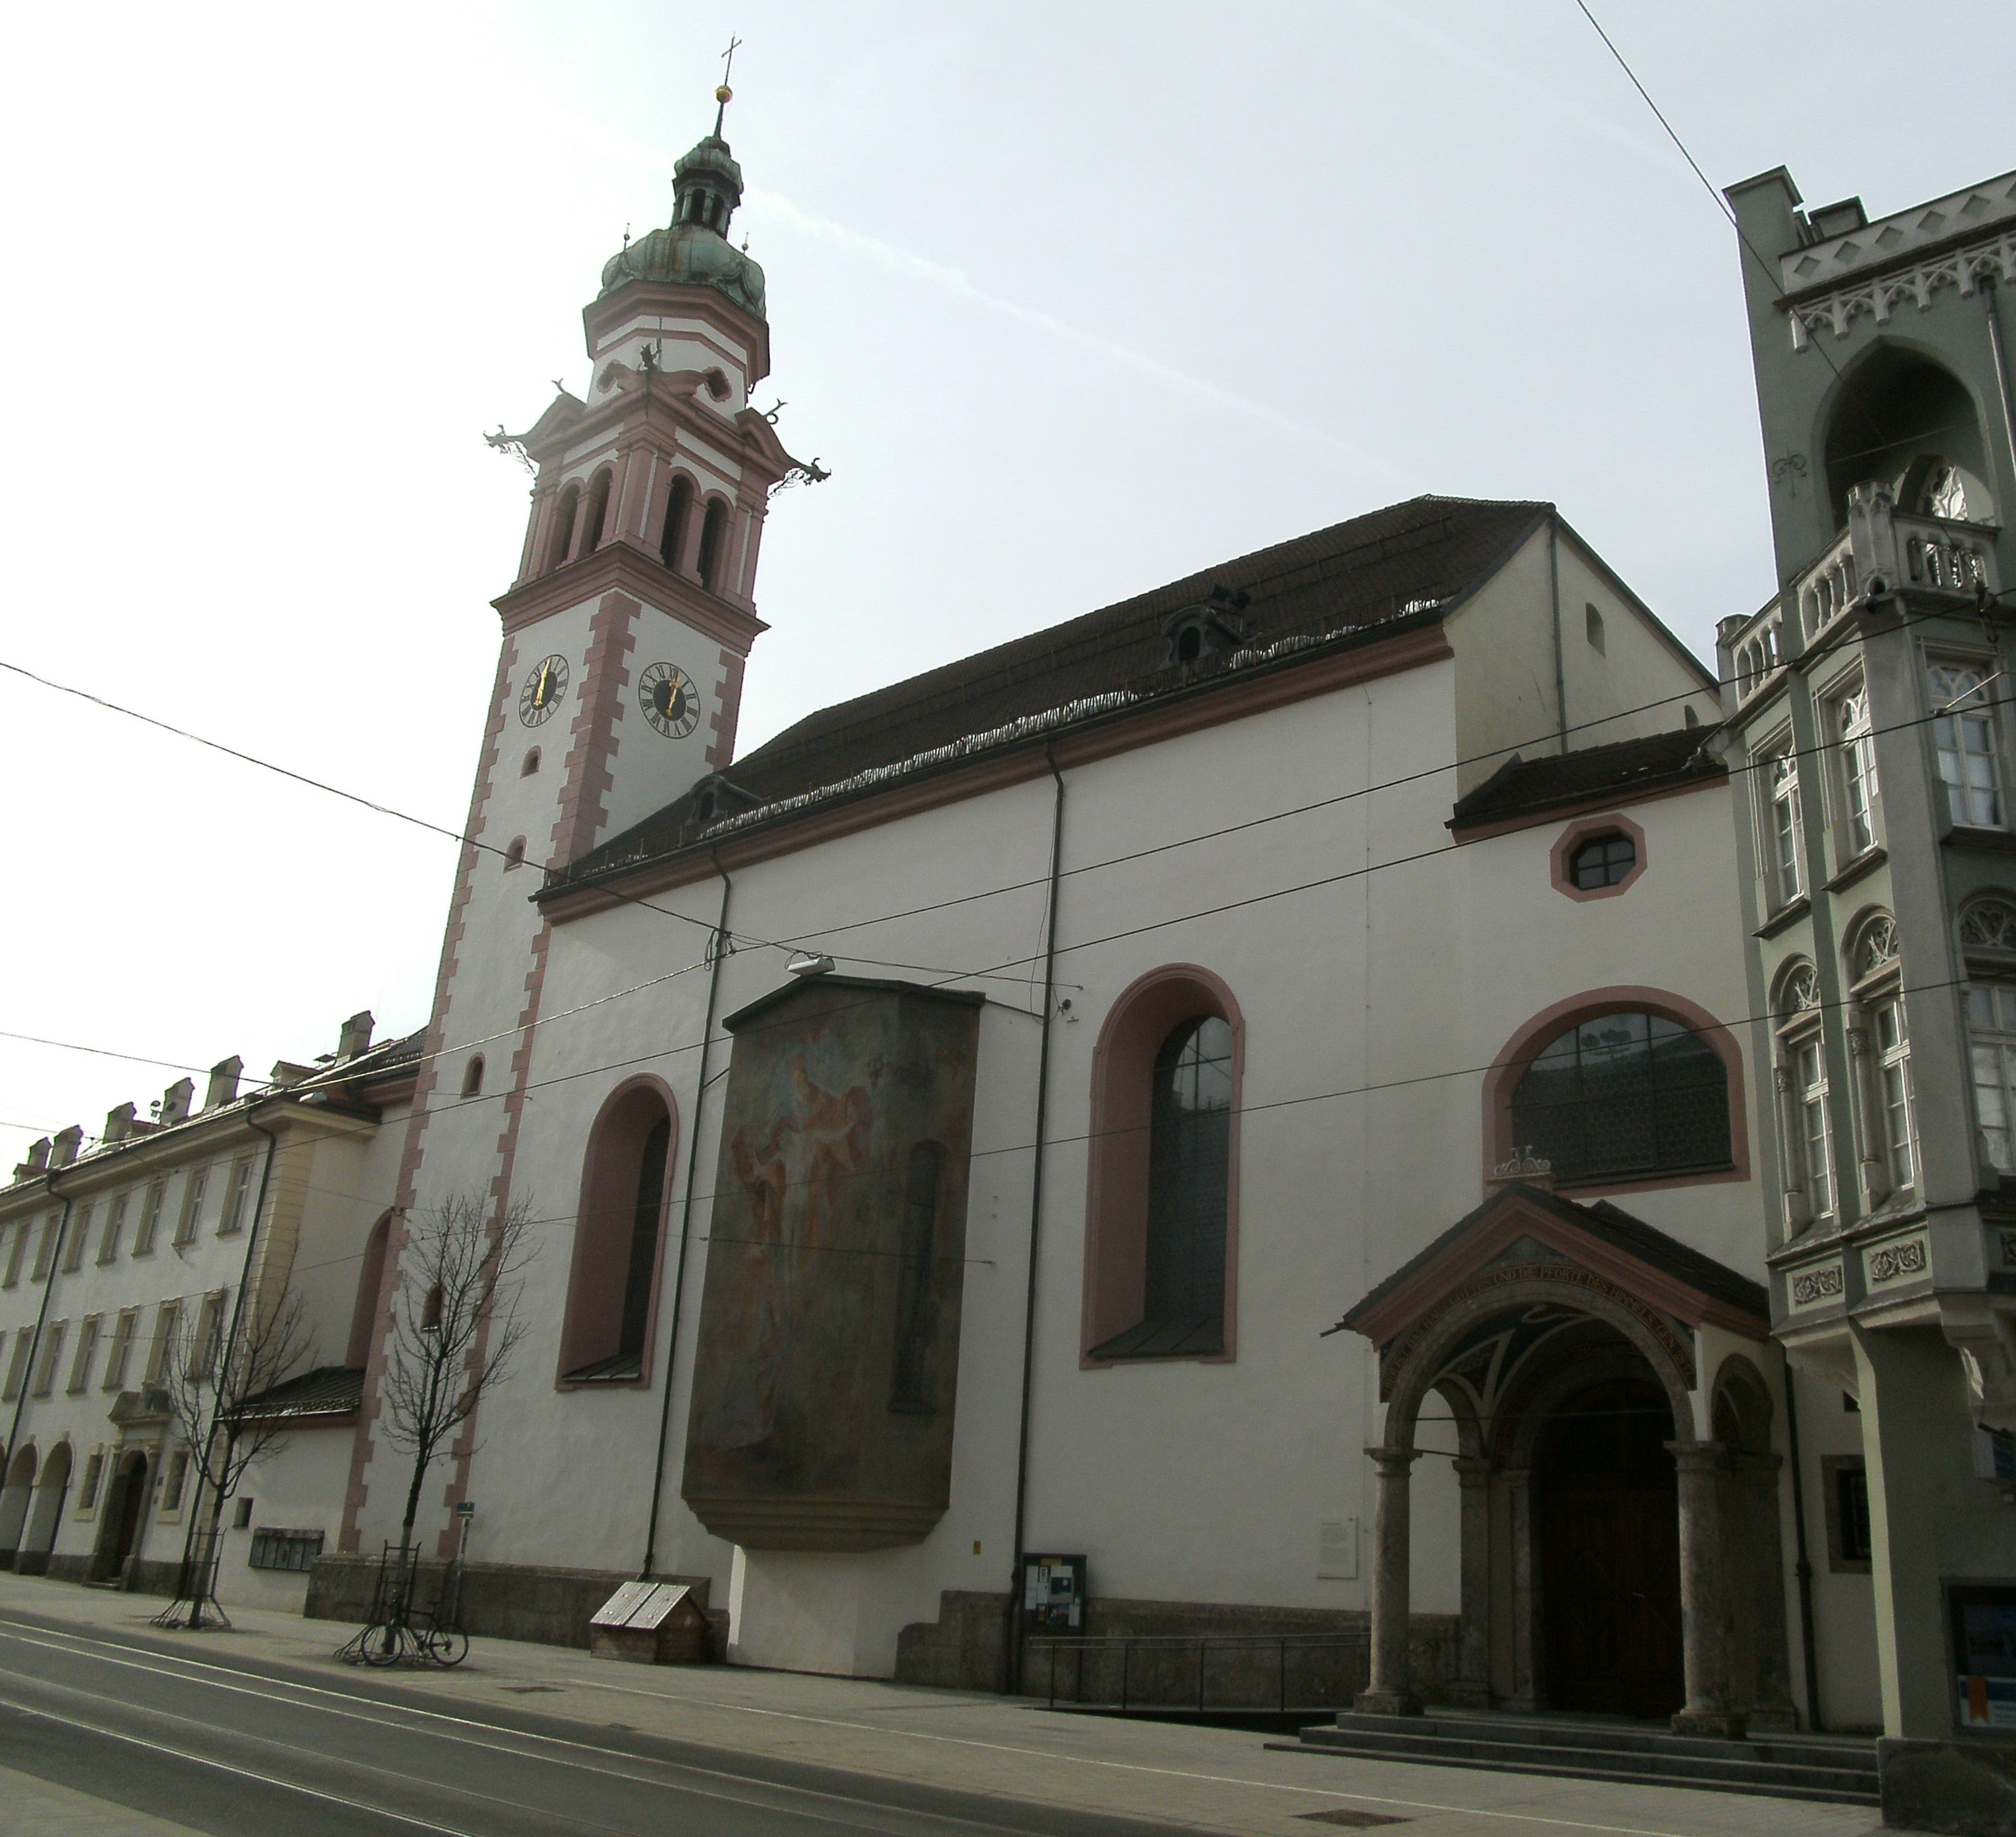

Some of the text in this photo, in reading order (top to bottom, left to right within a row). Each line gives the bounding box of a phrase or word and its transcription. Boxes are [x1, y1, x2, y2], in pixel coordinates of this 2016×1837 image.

[1492, 1269, 1516, 1285] UND
[1518, 1266, 1536, 1280] DIE
[1540, 1266, 1585, 1284] PFORTE
[1586, 1274, 1613, 1294] DES
[1609, 1285, 1656, 1324] HIMMELS
